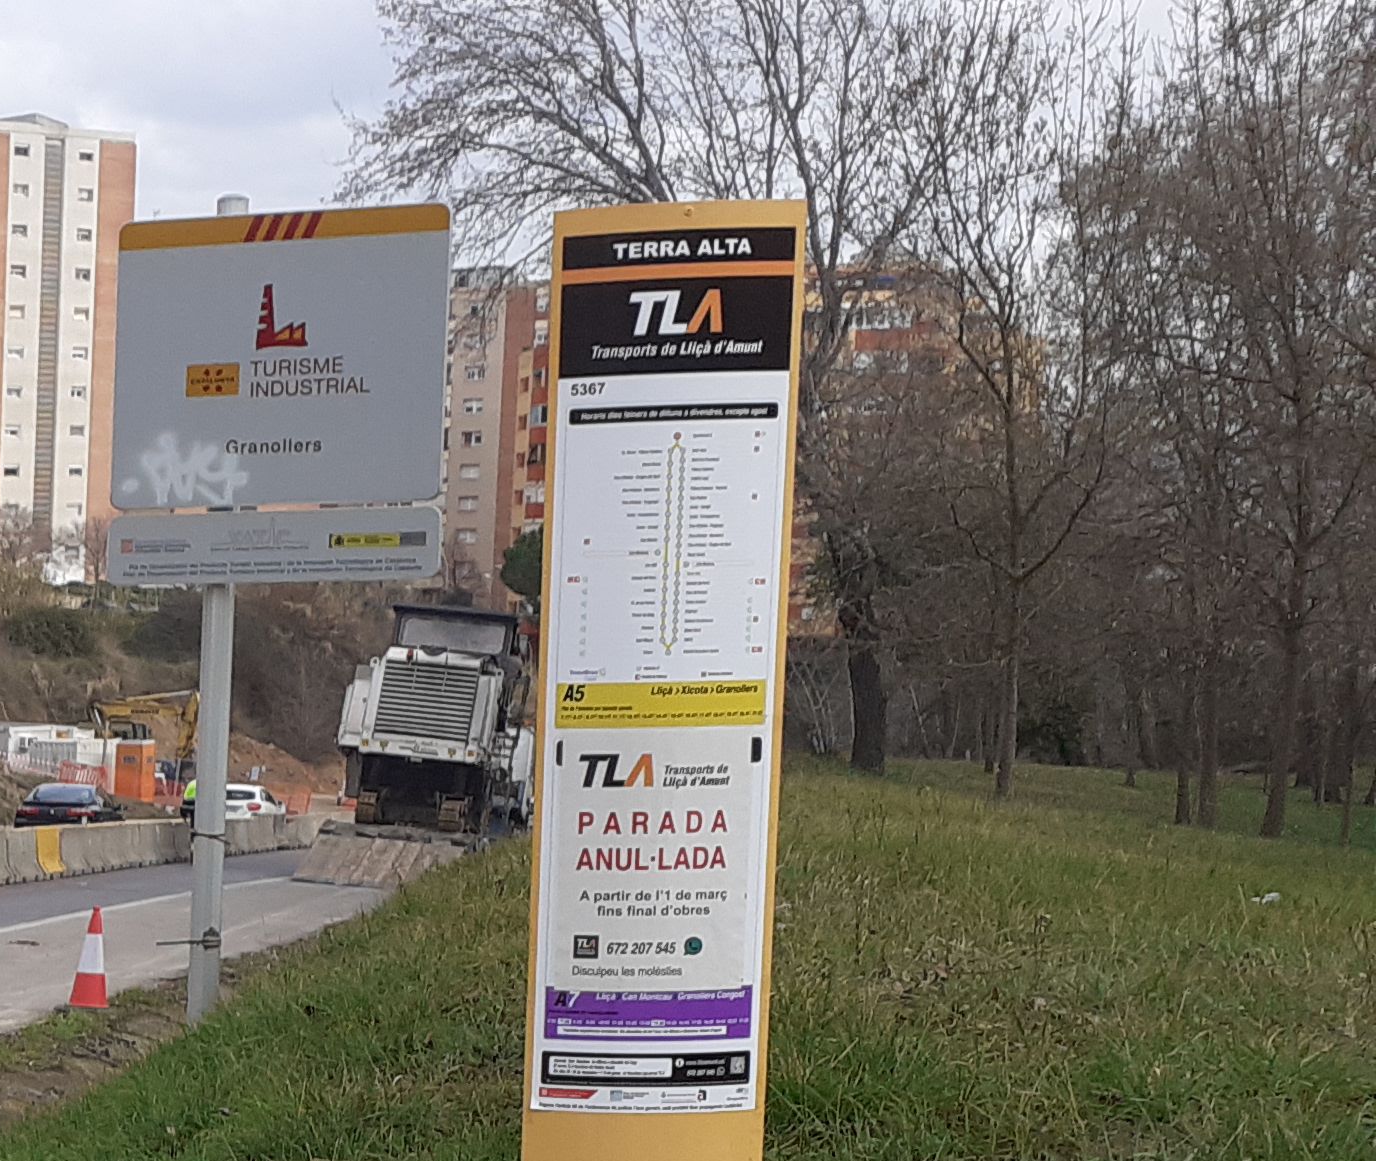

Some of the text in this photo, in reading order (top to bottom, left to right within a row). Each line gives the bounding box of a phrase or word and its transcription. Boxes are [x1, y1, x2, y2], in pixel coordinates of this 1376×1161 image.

[613, 238, 752, 260] TERRA ALTA
[628, 288, 724, 337] TLA
[591, 339, 763, 361] Transports de Lliçà d'Amunt
[249, 355, 344, 378] TURISME
[249, 375, 370, 398] INDUSTRIAL
[570, 381, 606, 397] 5367
[225, 438, 322, 455] Granollers
[562, 684, 586, 702] A5
[578, 753, 654, 788] TLA
[664, 763, 729, 775] Transports de
[577, 809, 728, 835] PARADA
[575, 845, 727, 872] ANUL·LADA
[579, 889, 590, 901] A
[593, 889, 631, 904] partir
[634, 889, 652, 901] de
[675, 889, 691, 900] de
[695, 890, 728, 902] març
[597, 904, 710, 917] fins final d'obres
[606, 941, 628, 955] 672
[630, 941, 653, 955] 207
[654, 941, 676, 955] 545
[571, 964, 619, 979] Disculpeu
[553, 989, 581, 1009] A7
